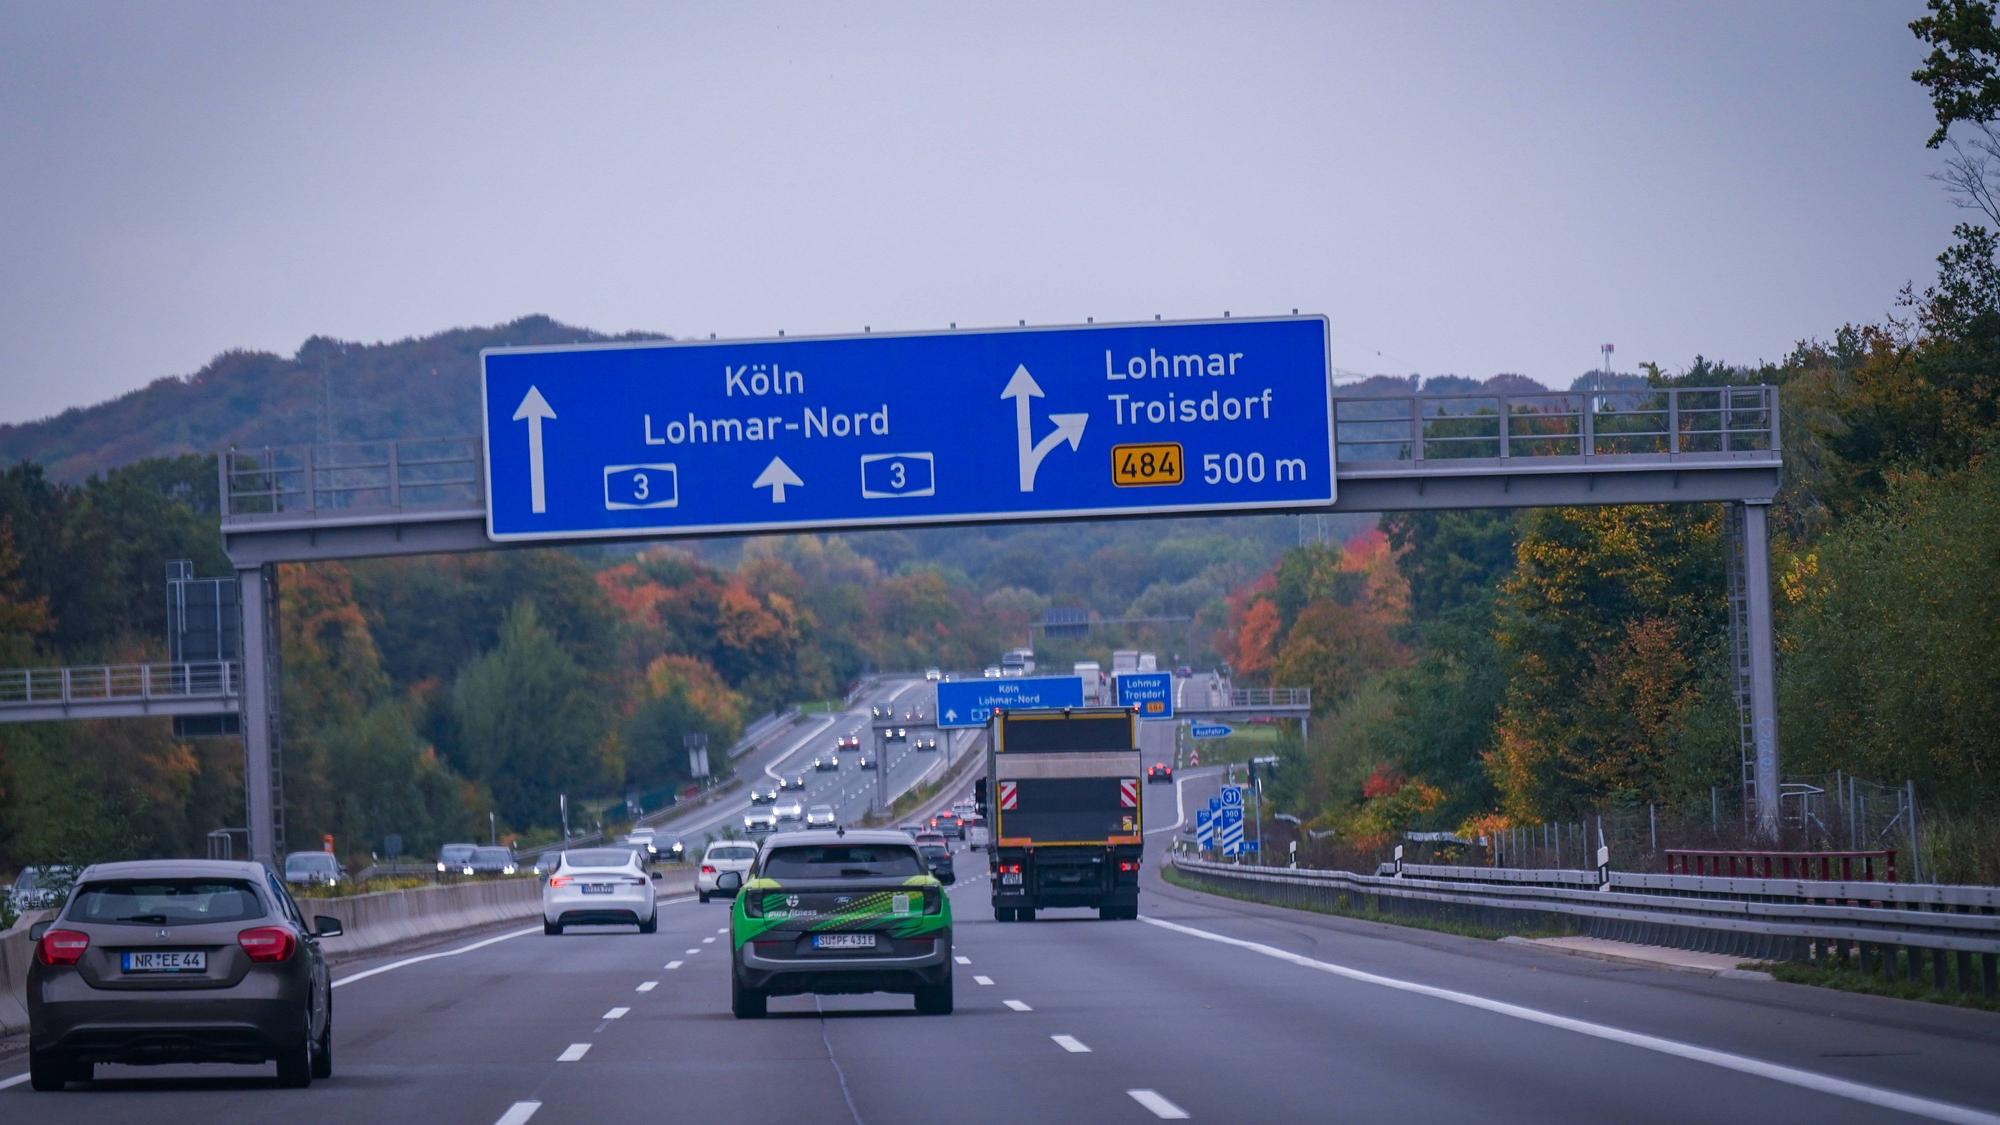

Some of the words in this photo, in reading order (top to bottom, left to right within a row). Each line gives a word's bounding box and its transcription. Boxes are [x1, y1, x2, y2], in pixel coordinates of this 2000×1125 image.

[1105, 348, 1244, 380] Lohmar
[725, 363, 804, 397] Köln
[1107, 388, 1273, 425] Troisdorf
[644, 404, 890, 446] Lohmar-Nord
[890, 462, 906, 489] 3
[1121, 451, 1175, 478] 484
[1203, 452, 1266, 485] 500
[1275, 457, 1307, 482] m
[633, 473, 650, 500] 3
[998, 684, 1020, 694] Köln
[1124, 689, 1166, 700] Troisdorf
[1127, 679, 1161, 688] Lohmar
[978, 694, 1040, 705] Lohmar-Nord
[1226, 791, 1237, 802] 31
[819, 935, 831, 946] SU
[836, 935, 848, 946] PF
[135, 954, 153, 967] NR
[162, 954, 180, 967] EE
[183, 953, 200, 967] 44
